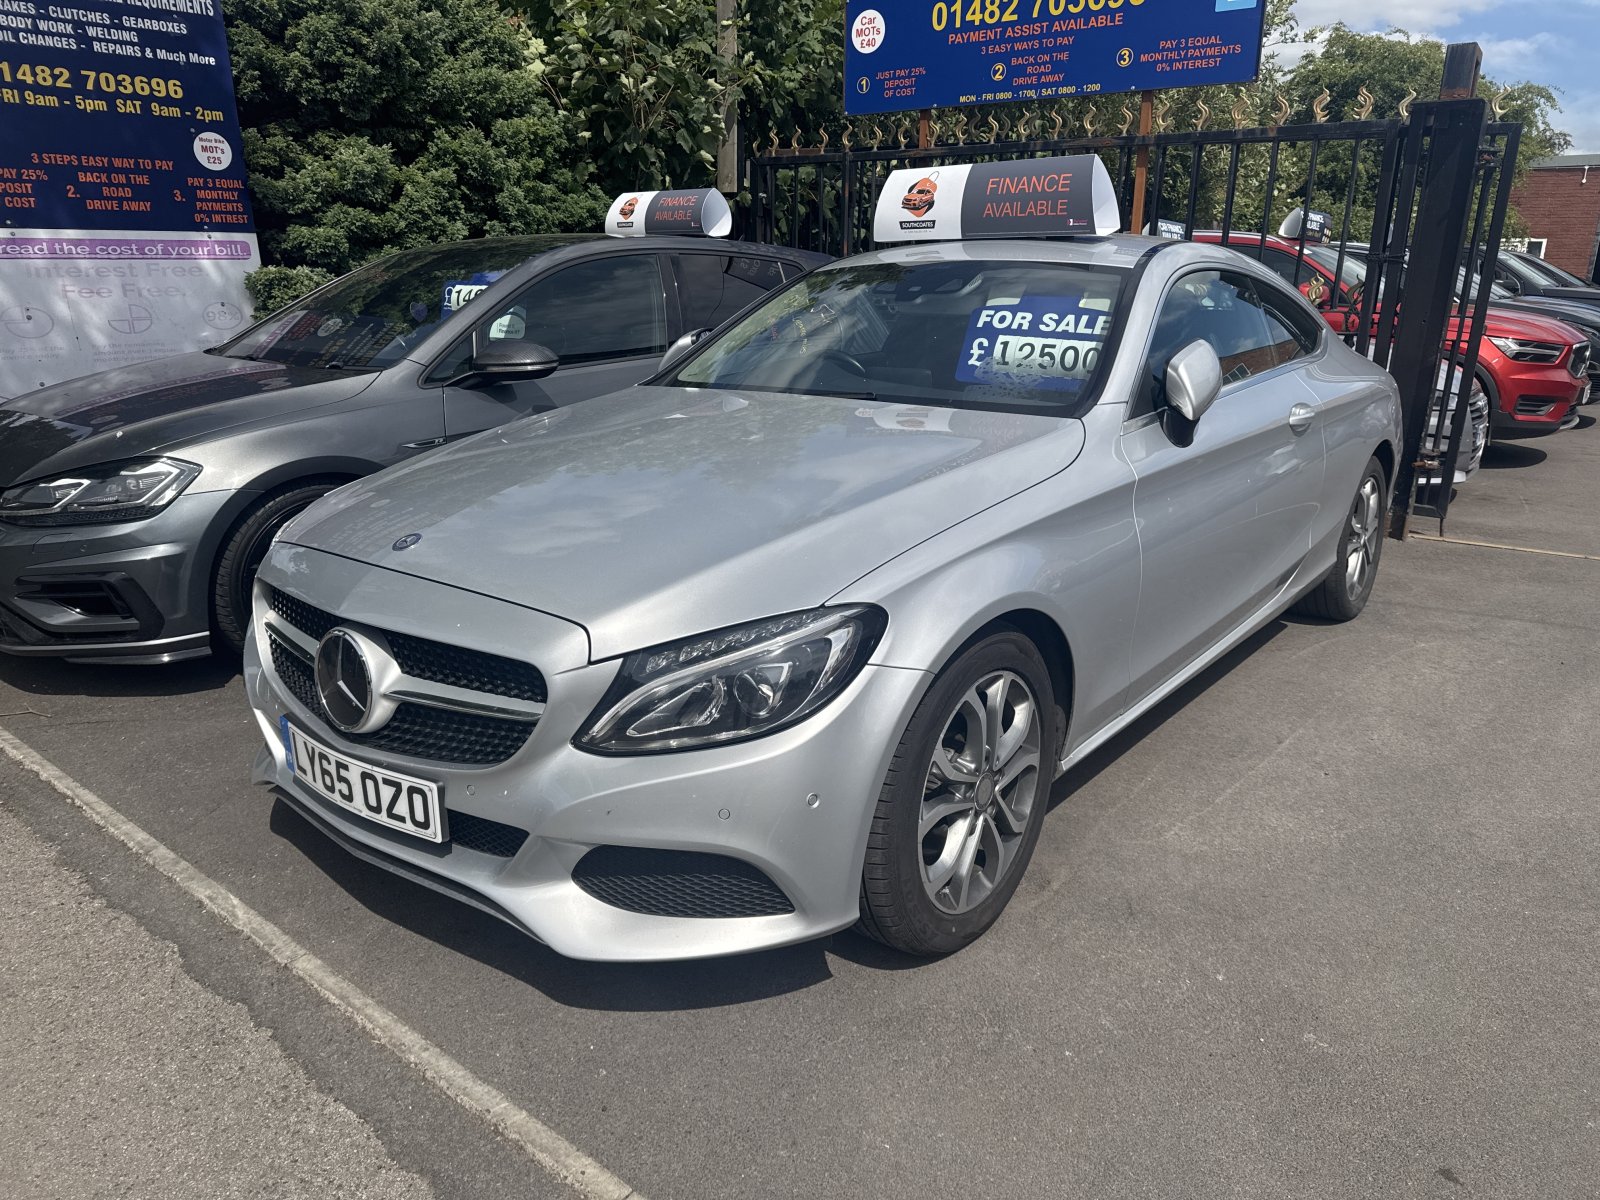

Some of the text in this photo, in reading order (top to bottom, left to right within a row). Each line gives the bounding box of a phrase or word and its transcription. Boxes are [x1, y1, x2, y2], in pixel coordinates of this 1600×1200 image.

[48, 6, 111, 25] CLUTCHES
[122, 16, 188, 34] GEARBOXES
[860, 16, 876, 26] Car
[931, 0, 1018, 31] 01482
[0, 14, 33, 30] BODY
[36, 18, 75, 35] WORK
[85, 25, 139, 42] WELDING
[855, 27, 881, 38] MOTs
[948, 13, 1124, 44] PAYMENT ASSIST AVAILABLE
[19, 31, 77, 50] CHANGES
[92, 41, 142, 57] REPAIRS
[145, 47, 153, 59] &
[156, 50, 187, 63] Much
[188, 52, 216, 66] More
[860, 37, 876, 49] £40
[981, 36, 1074, 55] 3 EASY WAYS TO PAY
[1159, 35, 1222, 49] PAY 3 EQUAL
[1011, 51, 1069, 66] BACK ON THE
[1119, 49, 1130, 66] 3
[1140, 44, 1241, 63] MONTHLY PAYMENTS
[993, 64, 1004, 80] 2
[1026, 63, 1052, 74] ROAD
[1156, 58, 1222, 72] 0% INTEREST
[0, 61, 184, 99] 1482 703696
[875, 66, 926, 80] JUST PAY 25%
[1012, 73, 1064, 86] DRIVE AWAY
[884, 77, 916, 89] DEPOSIT
[884, 87, 916, 98] OF COST
[959, 94, 976, 103] MON
[982, 92, 993, 101] FRI
[995, 91, 1012, 101] 0800
[1018, 89, 1035, 99] 1700
[1041, 86, 1056, 96] SAT
[1058, 86, 1076, 95] 0800
[1083, 83, 1101, 93] 1200
[0, 88, 20, 104] RI
[24, 90, 59, 107] 9am
[75, 95, 108, 112] 5pm
[116, 99, 142, 115] SAT
[151, 104, 181, 118] 9am
[195, 106, 224, 122] 2pm
[201, 145, 225, 155] MOT's
[31, 152, 174, 171] 3 STEPS EASY WAY TO PAY
[206, 156, 223, 165] £25
[21, 168, 48, 181] 25%
[78, 171, 151, 185] BACK ON THE
[187, 177, 245, 189] PAY 3 EQUAL
[986, 173, 1072, 196] FINANCE
[66, 184, 81, 198] 2.
[102, 186, 132, 198] ROAD
[173, 190, 186, 202] 3.
[196, 189, 239, 201] MONTHLY
[4, 196, 36, 208] COST
[86, 199, 151, 212] DRIVE AWAY
[196, 201, 244, 213] PAYMENTS
[658, 195, 699, 207] FINANCE
[655, 210, 692, 221] AVAILABLE
[983, 199, 1068, 218] AVAILABLE
[194, 213, 249, 224] 0% INTREST
[54, 240, 90, 255] the
[95, 243, 139, 255] cost
[150, 240, 164, 256] of
[170, 244, 212, 260] your
[215, 241, 247, 256] bill.
[25, 261, 208, 279] Interest Free.
[62, 282, 187, 299] Fee Free.
[976, 310, 1112, 335] FOR SALE
[291, 732, 431, 831] LY65 OZO
